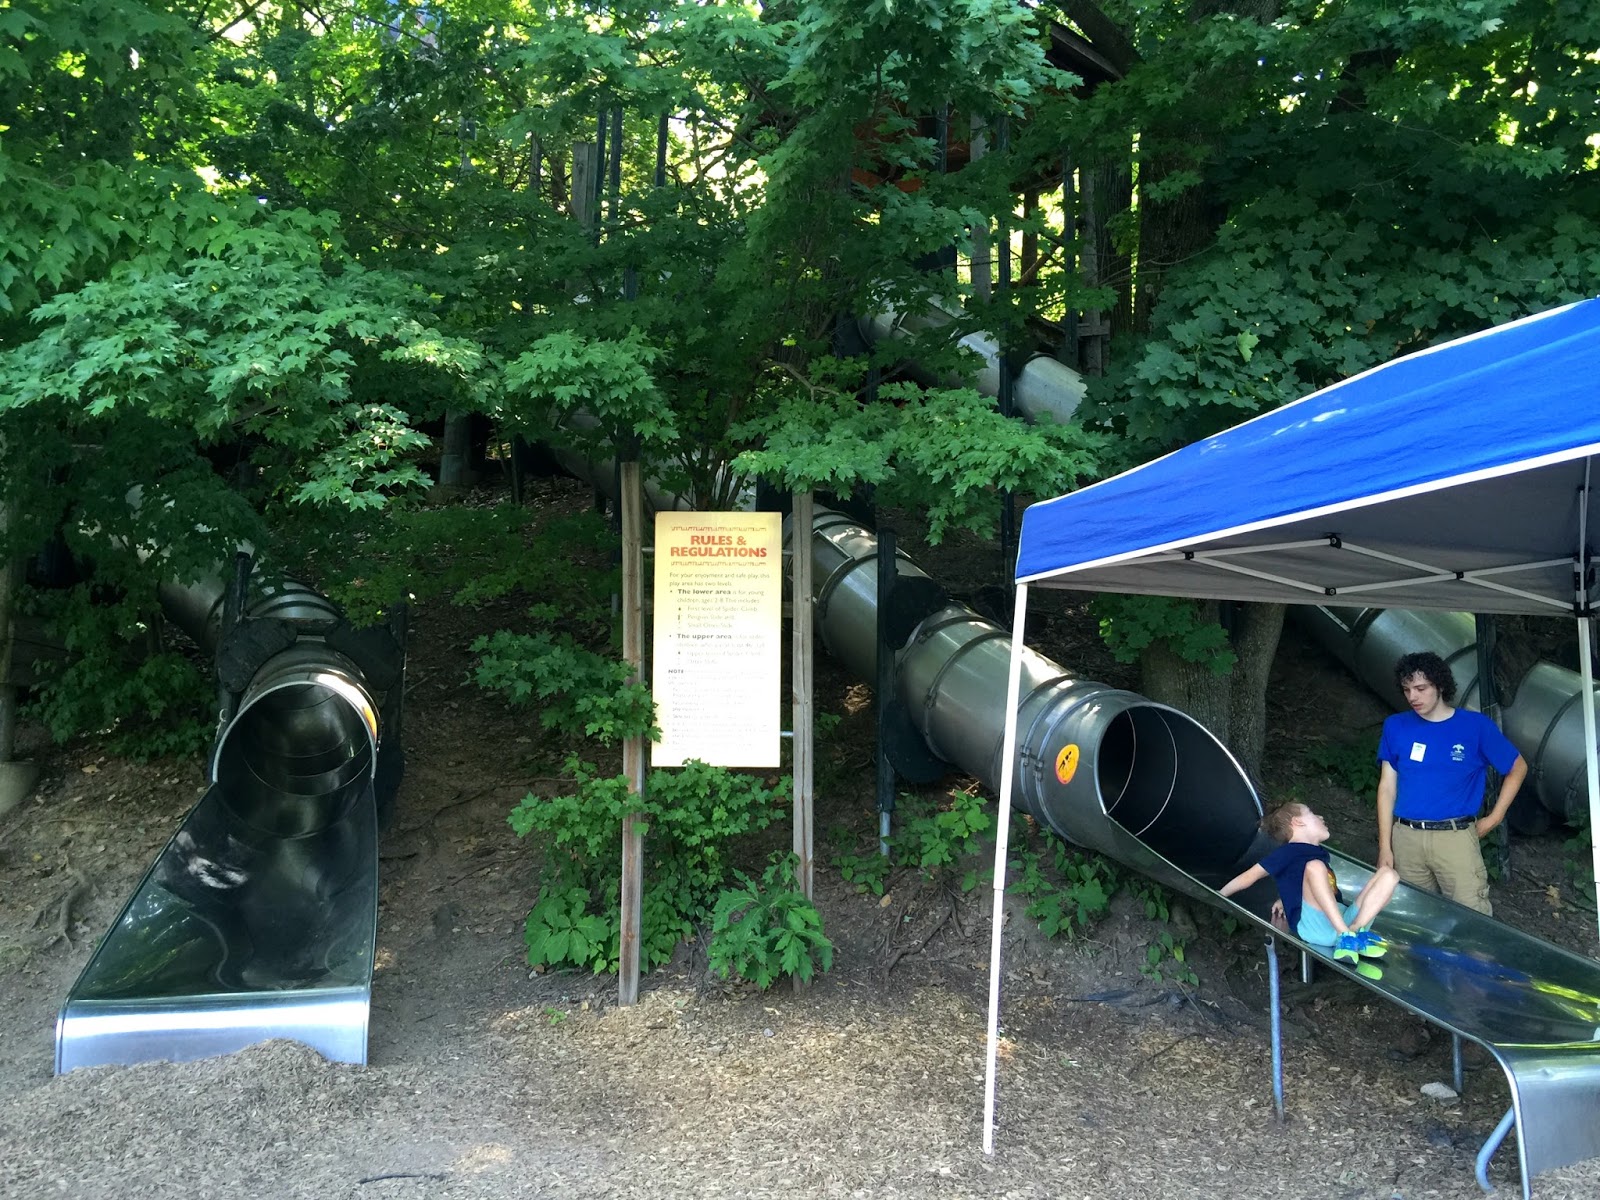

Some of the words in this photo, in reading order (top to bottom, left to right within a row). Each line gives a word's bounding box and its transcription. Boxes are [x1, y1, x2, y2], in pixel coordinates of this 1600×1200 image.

[690, 536, 732, 545] RULES
[736, 536, 747, 546] &
[670, 547, 768, 557] REGULATIONS
